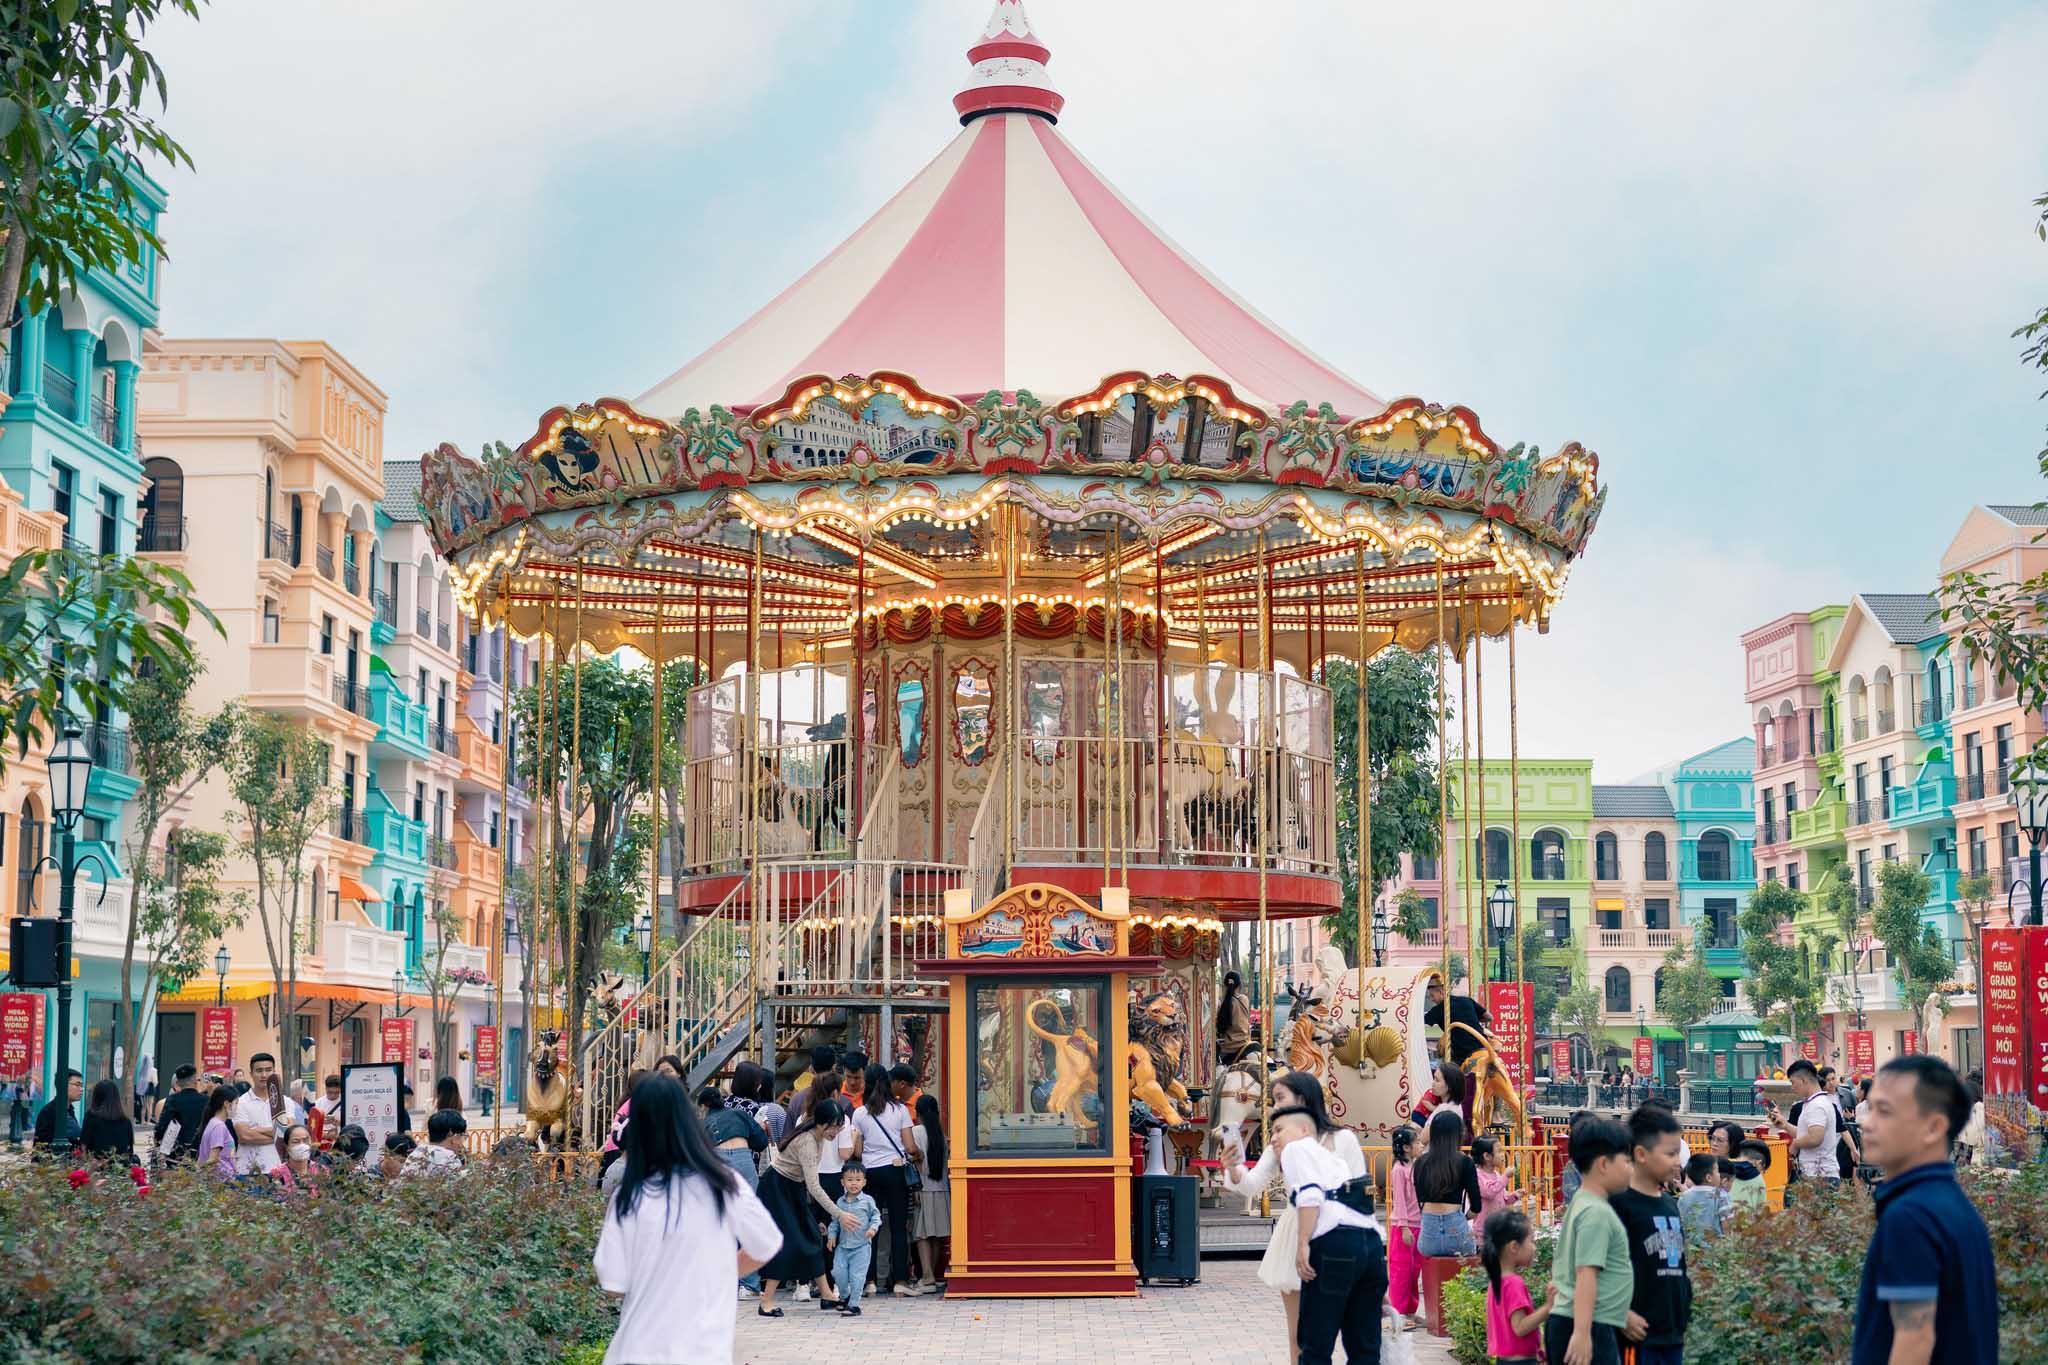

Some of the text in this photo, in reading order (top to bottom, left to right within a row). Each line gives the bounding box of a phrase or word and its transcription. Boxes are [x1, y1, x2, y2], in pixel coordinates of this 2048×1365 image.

[1993, 961, 2013, 971] MEGA
[1990, 975, 2017, 986] GRAND
[1990, 989, 2017, 999] WORLD
[1495, 1020, 1508, 1032] LỄ
[1500, 1042, 1522, 1053] NHẤ
[1995, 1036, 2013, 1053] MỚI
[3, 1050, 26, 1059] 21.12
